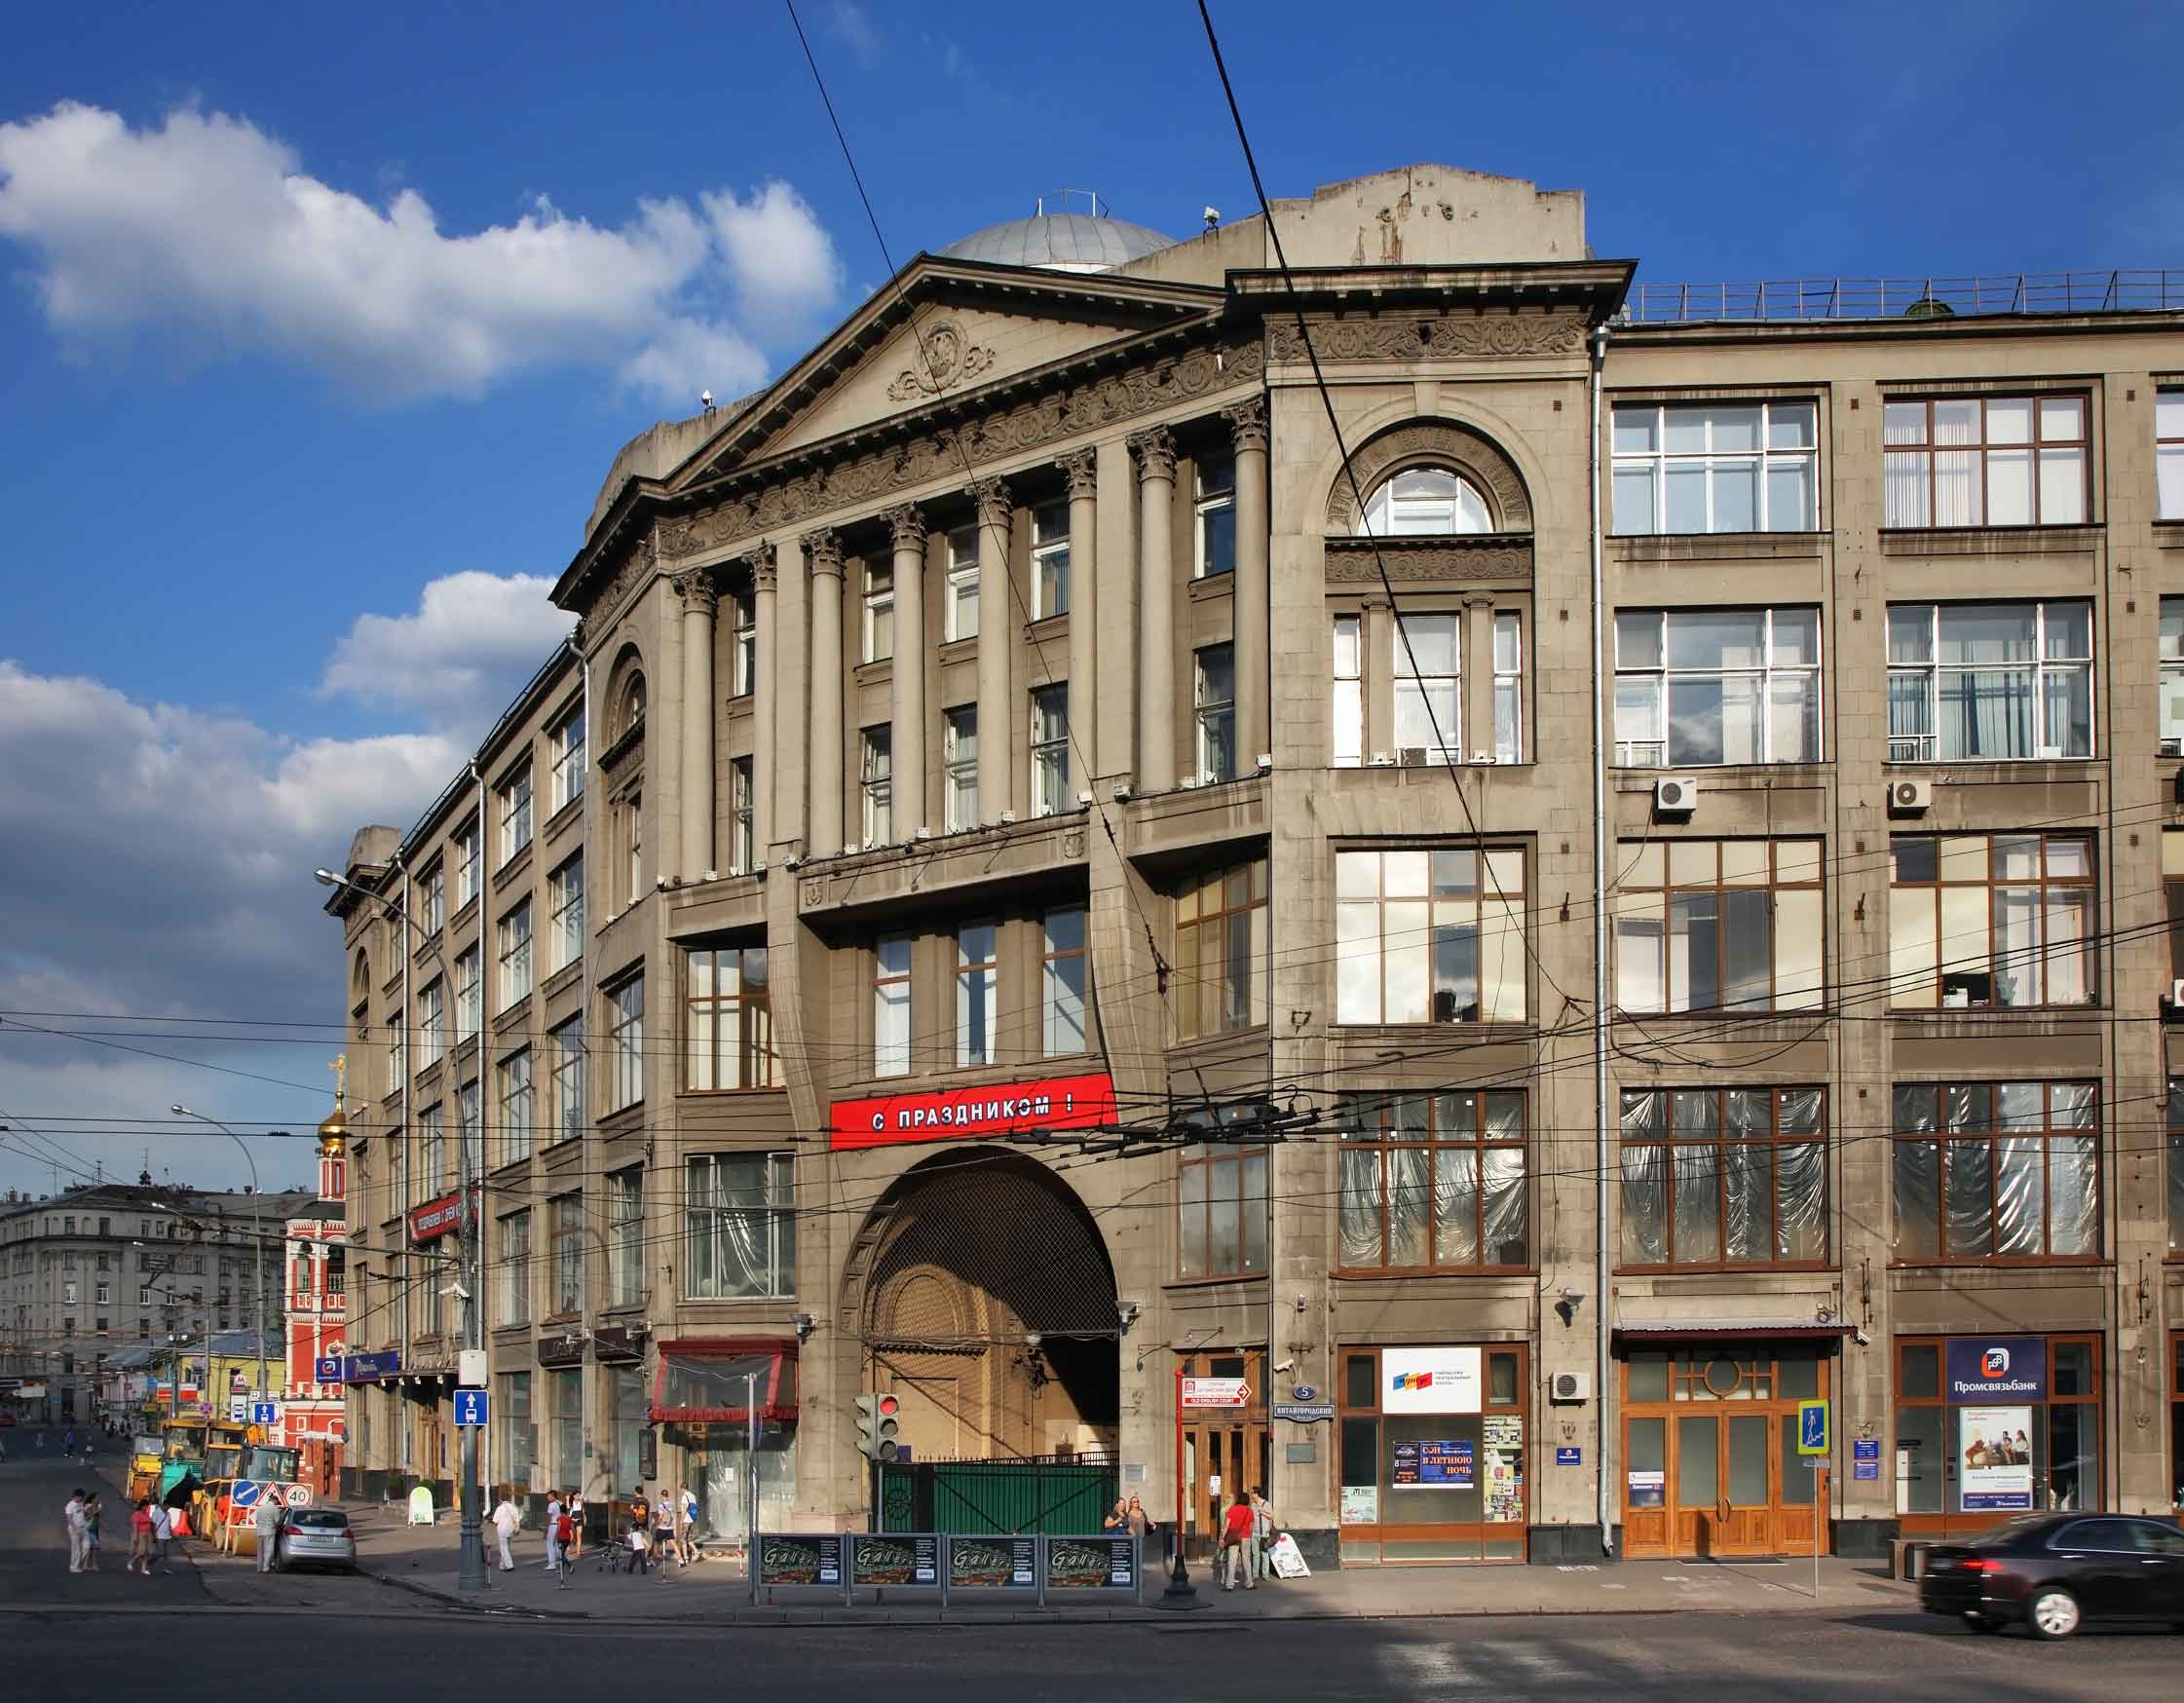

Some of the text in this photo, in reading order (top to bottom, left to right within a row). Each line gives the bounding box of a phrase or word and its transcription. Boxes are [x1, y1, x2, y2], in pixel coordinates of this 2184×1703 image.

[872, 1114, 885, 1130] С
[898, 1096, 1049, 1128] ПРАЗДНИКОМ
[1301, 1386, 1309, 1397] 5
[1954, 1380, 2037, 1394] Промсвязьбанк
[289, 1492, 306, 1502] 40
